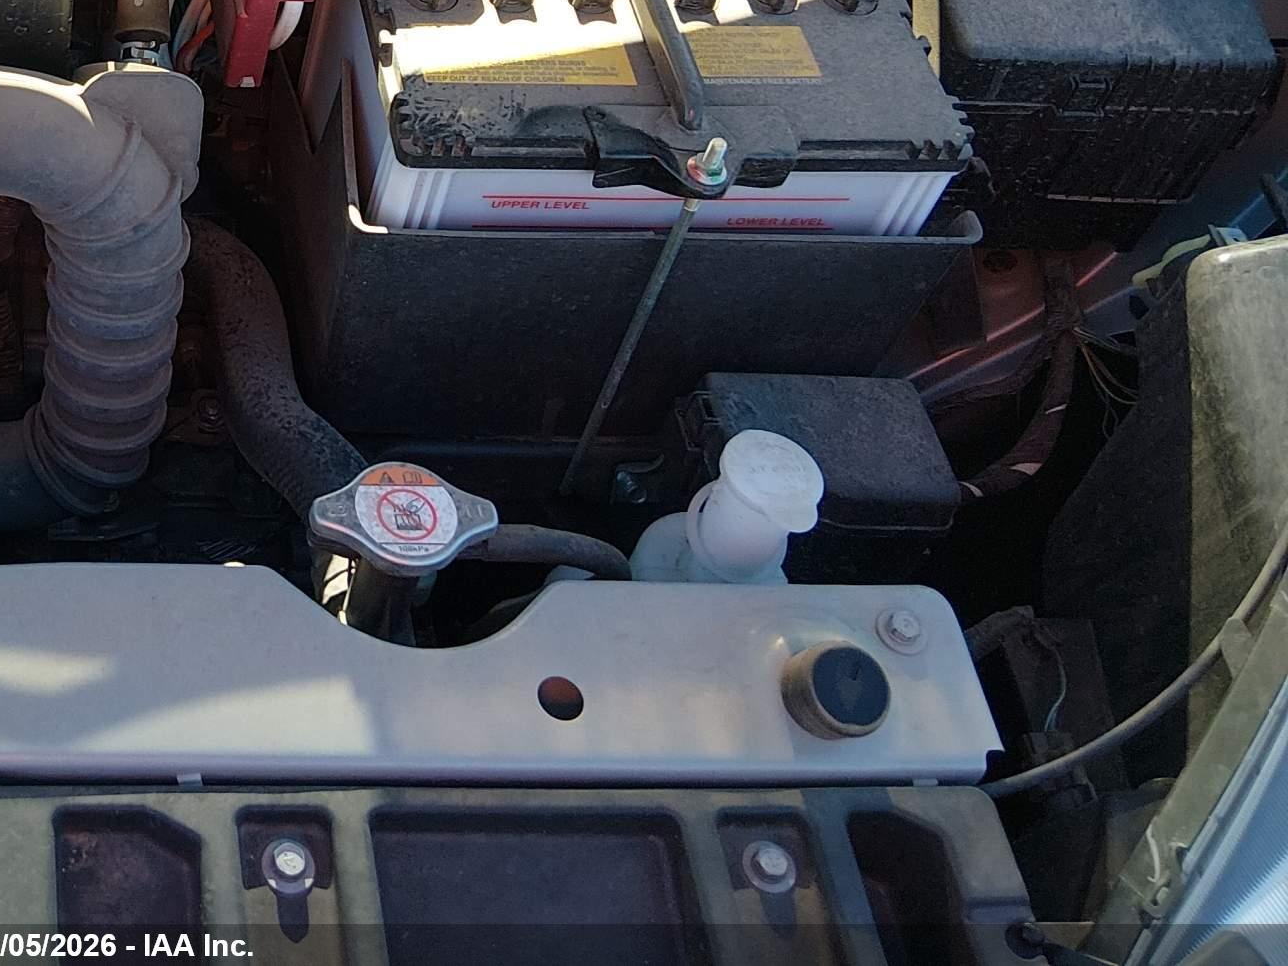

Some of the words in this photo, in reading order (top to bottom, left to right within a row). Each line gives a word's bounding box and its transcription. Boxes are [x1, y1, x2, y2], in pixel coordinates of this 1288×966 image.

[523, 75, 566, 83] CHILDREN
[492, 200, 540, 209] UPPER
[543, 201, 590, 210] LEVEL
[727, 217, 777, 226] LOWER
[780, 217, 825, 227] LEVEL
